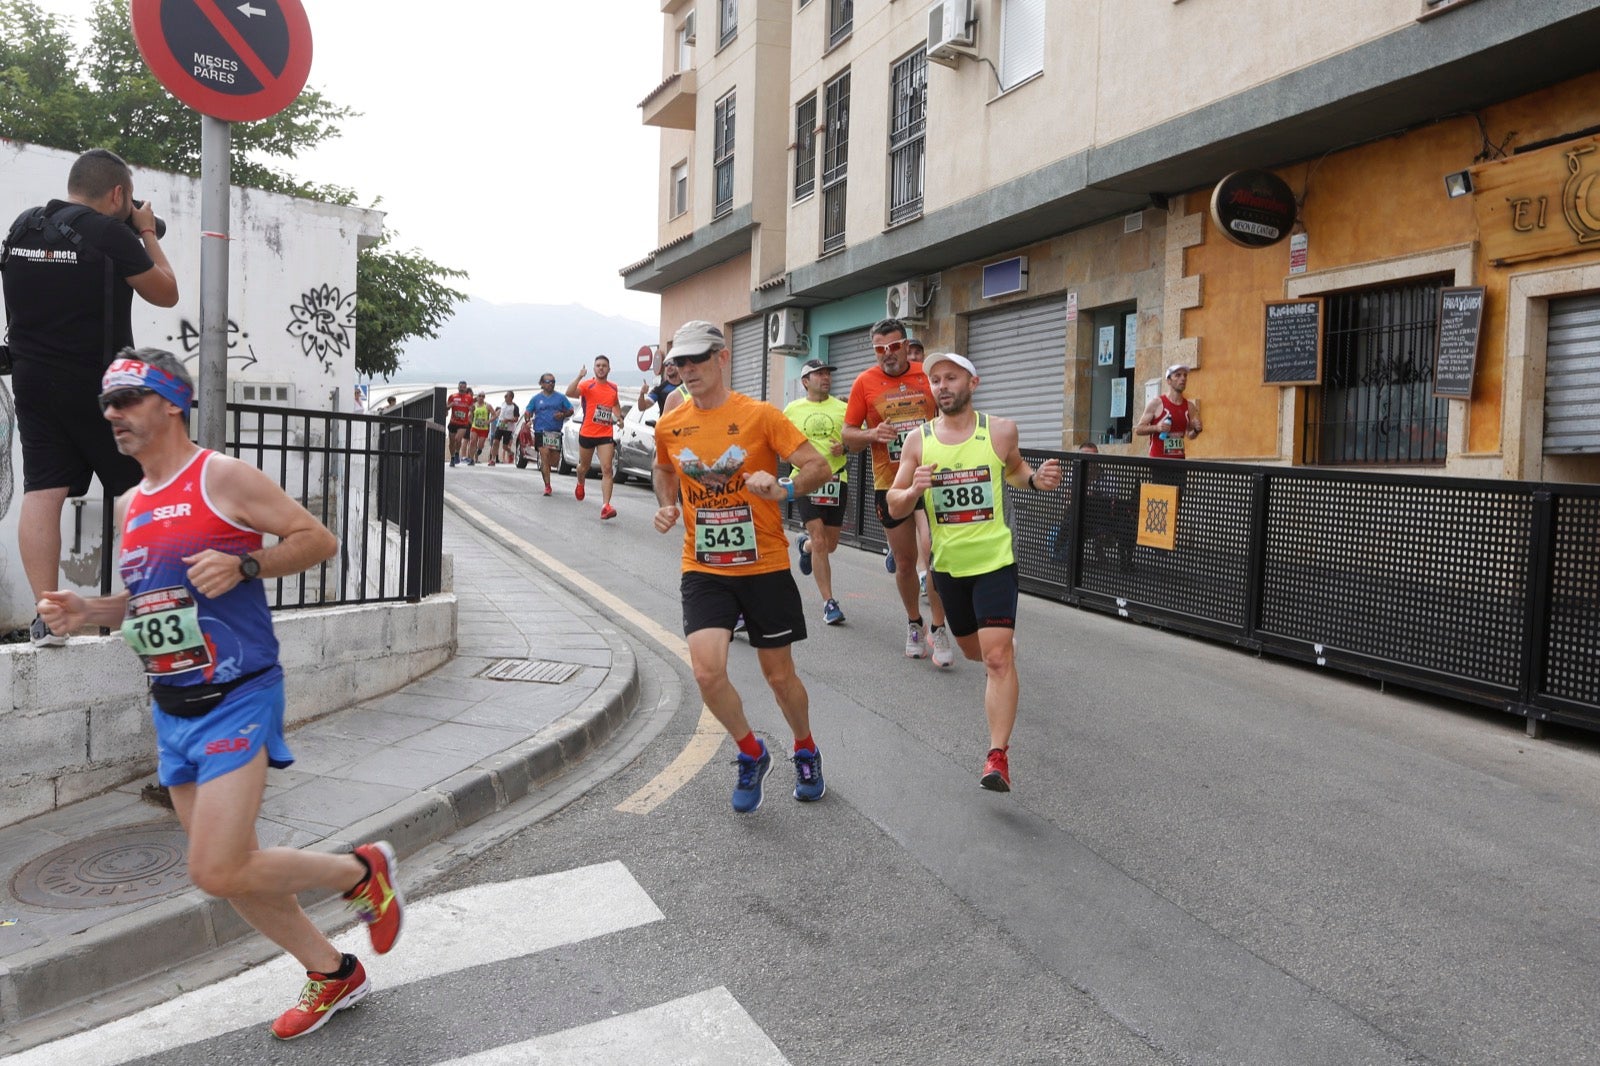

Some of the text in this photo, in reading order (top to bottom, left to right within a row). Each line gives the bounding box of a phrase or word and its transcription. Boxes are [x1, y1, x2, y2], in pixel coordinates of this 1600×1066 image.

[194, 52, 238, 72] MESES
[194, 66, 235, 84] PARES
[942, 485, 985, 508] 388
[152, 503, 192, 521] SEUR
[704, 526, 745, 548] 543
[204, 737, 250, 755] SEUR
